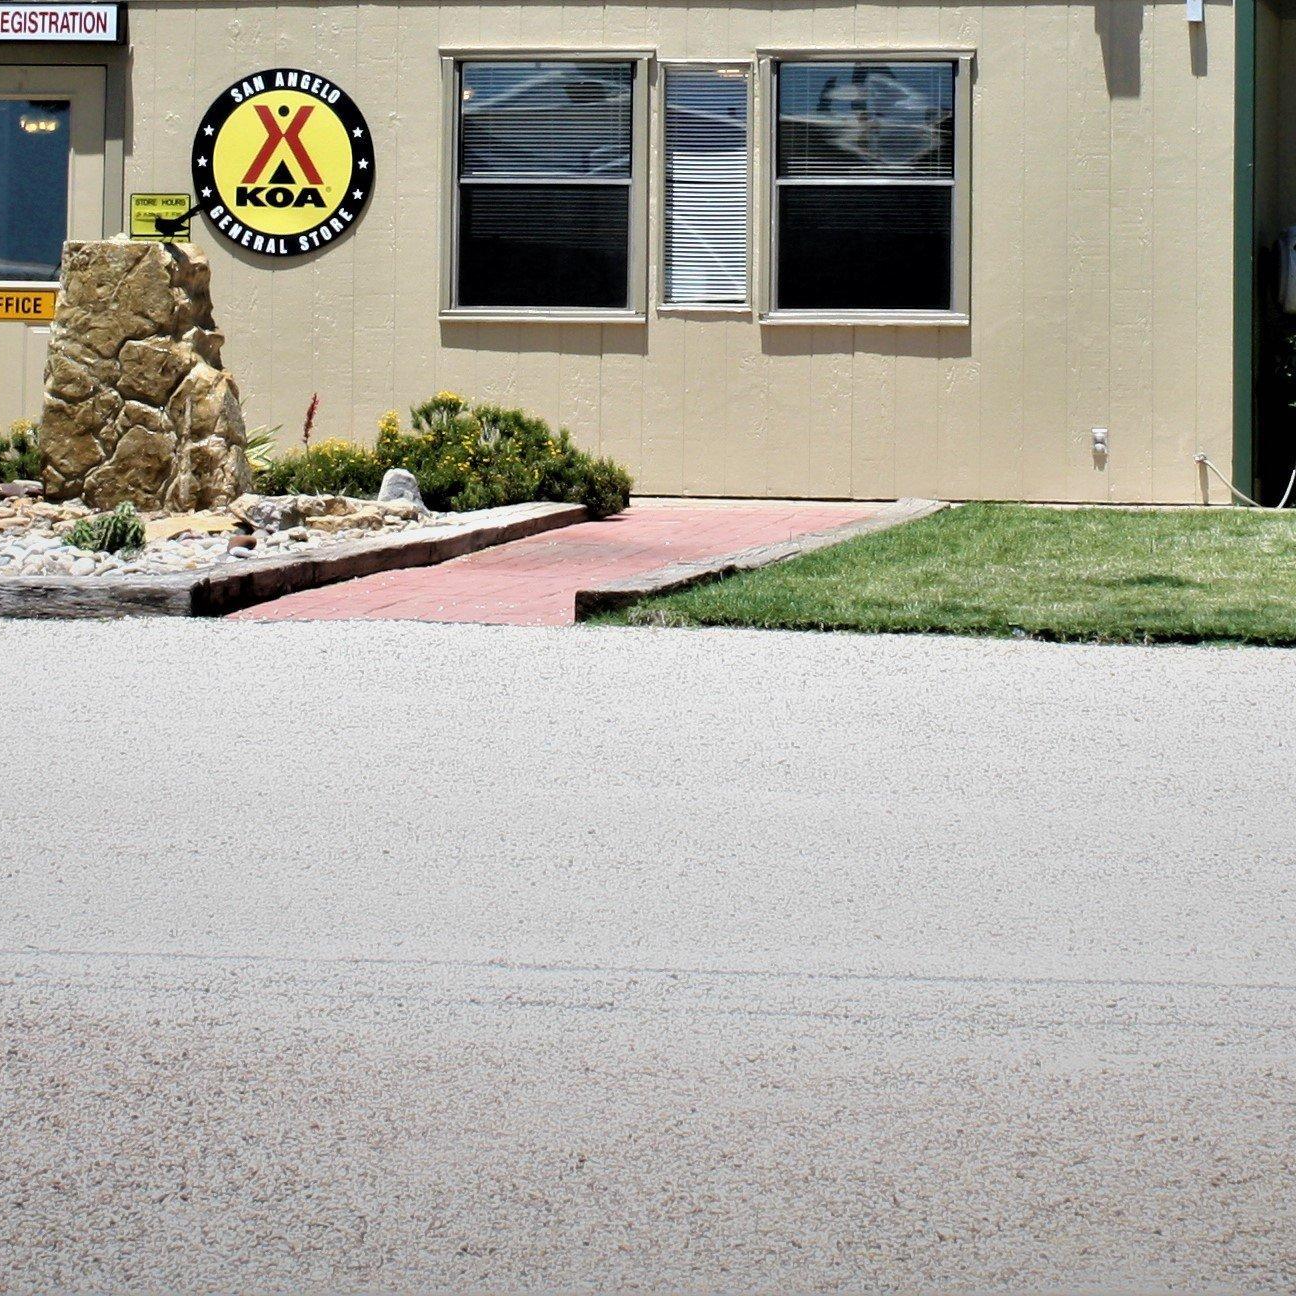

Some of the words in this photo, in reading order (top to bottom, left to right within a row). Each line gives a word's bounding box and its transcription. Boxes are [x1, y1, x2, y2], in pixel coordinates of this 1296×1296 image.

[230, 75, 265, 103] SAN
[275, 71, 342, 104] ANGELO
[235, 186, 327, 208] KOA
[209, 205, 288, 254] GENERAL
[298, 207, 354, 251] STORE
